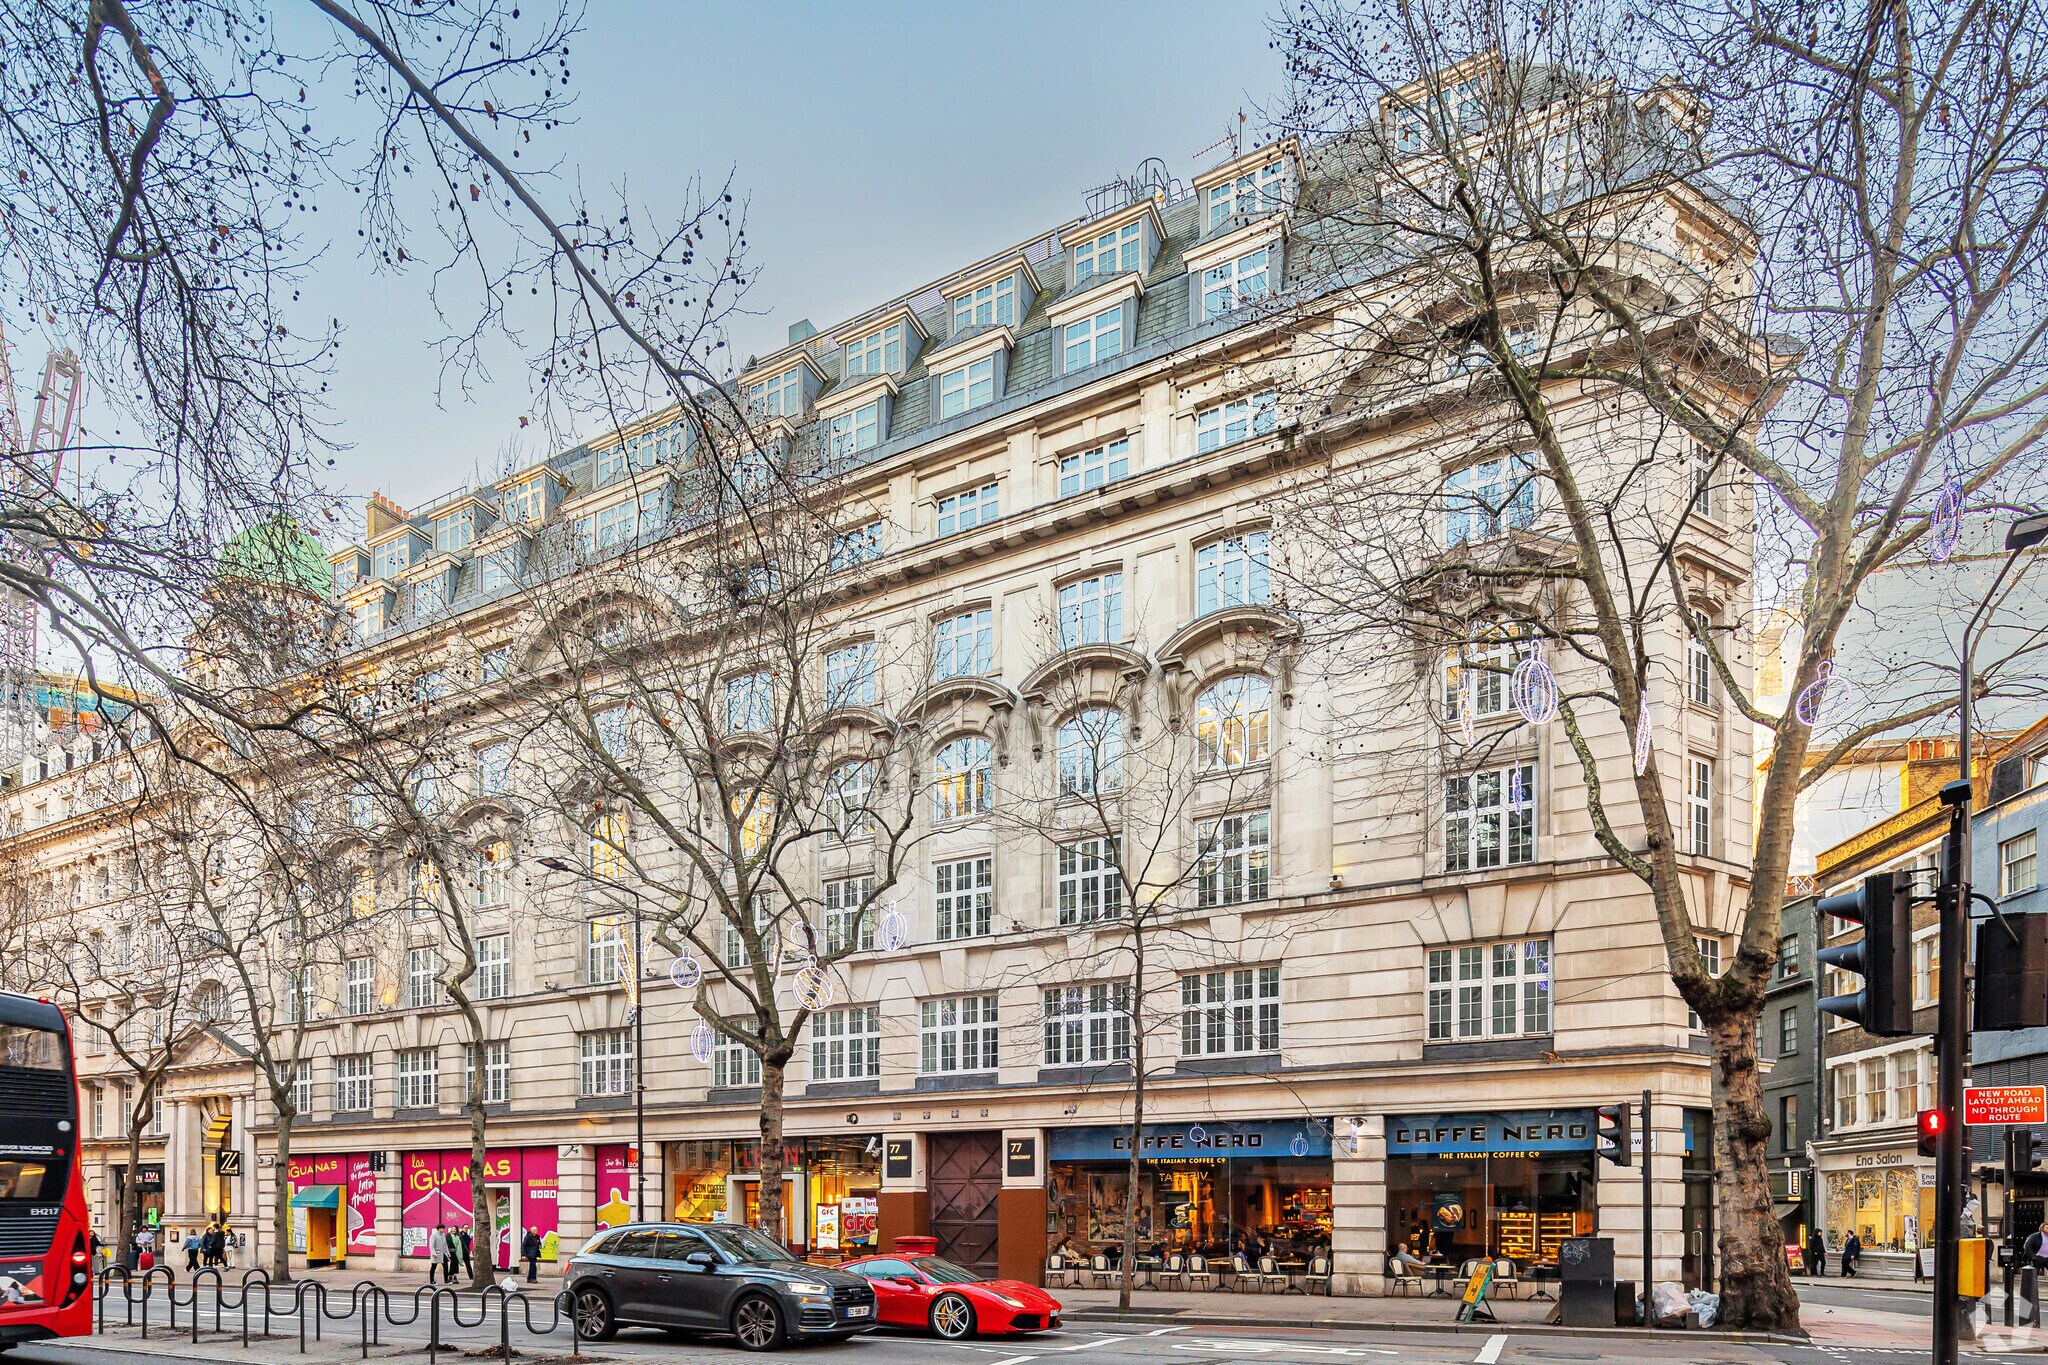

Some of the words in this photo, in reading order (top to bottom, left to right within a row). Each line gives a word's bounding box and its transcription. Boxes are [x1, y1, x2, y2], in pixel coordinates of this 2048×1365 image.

[1396, 1123, 1487, 1144] CAFFÈ
[1503, 1123, 1587, 1141] NERO
[1010, 1143, 1022, 1152] 77
[1196, 1134, 1263, 1148] NERO
[890, 1144, 900, 1153] 77
[743, 1146, 798, 1167] LEN
[1856, 1155, 1873, 1166] Ena
[1876, 1153, 1902, 1165] Salon
[288, 1161, 337, 1178] IGUANAS
[358, 1178, 374, 1194] Latin
[693, 1184, 706, 1193] LEON
[707, 1184, 726, 1194] COFFEE
[844, 1215, 876, 1230] GFC
